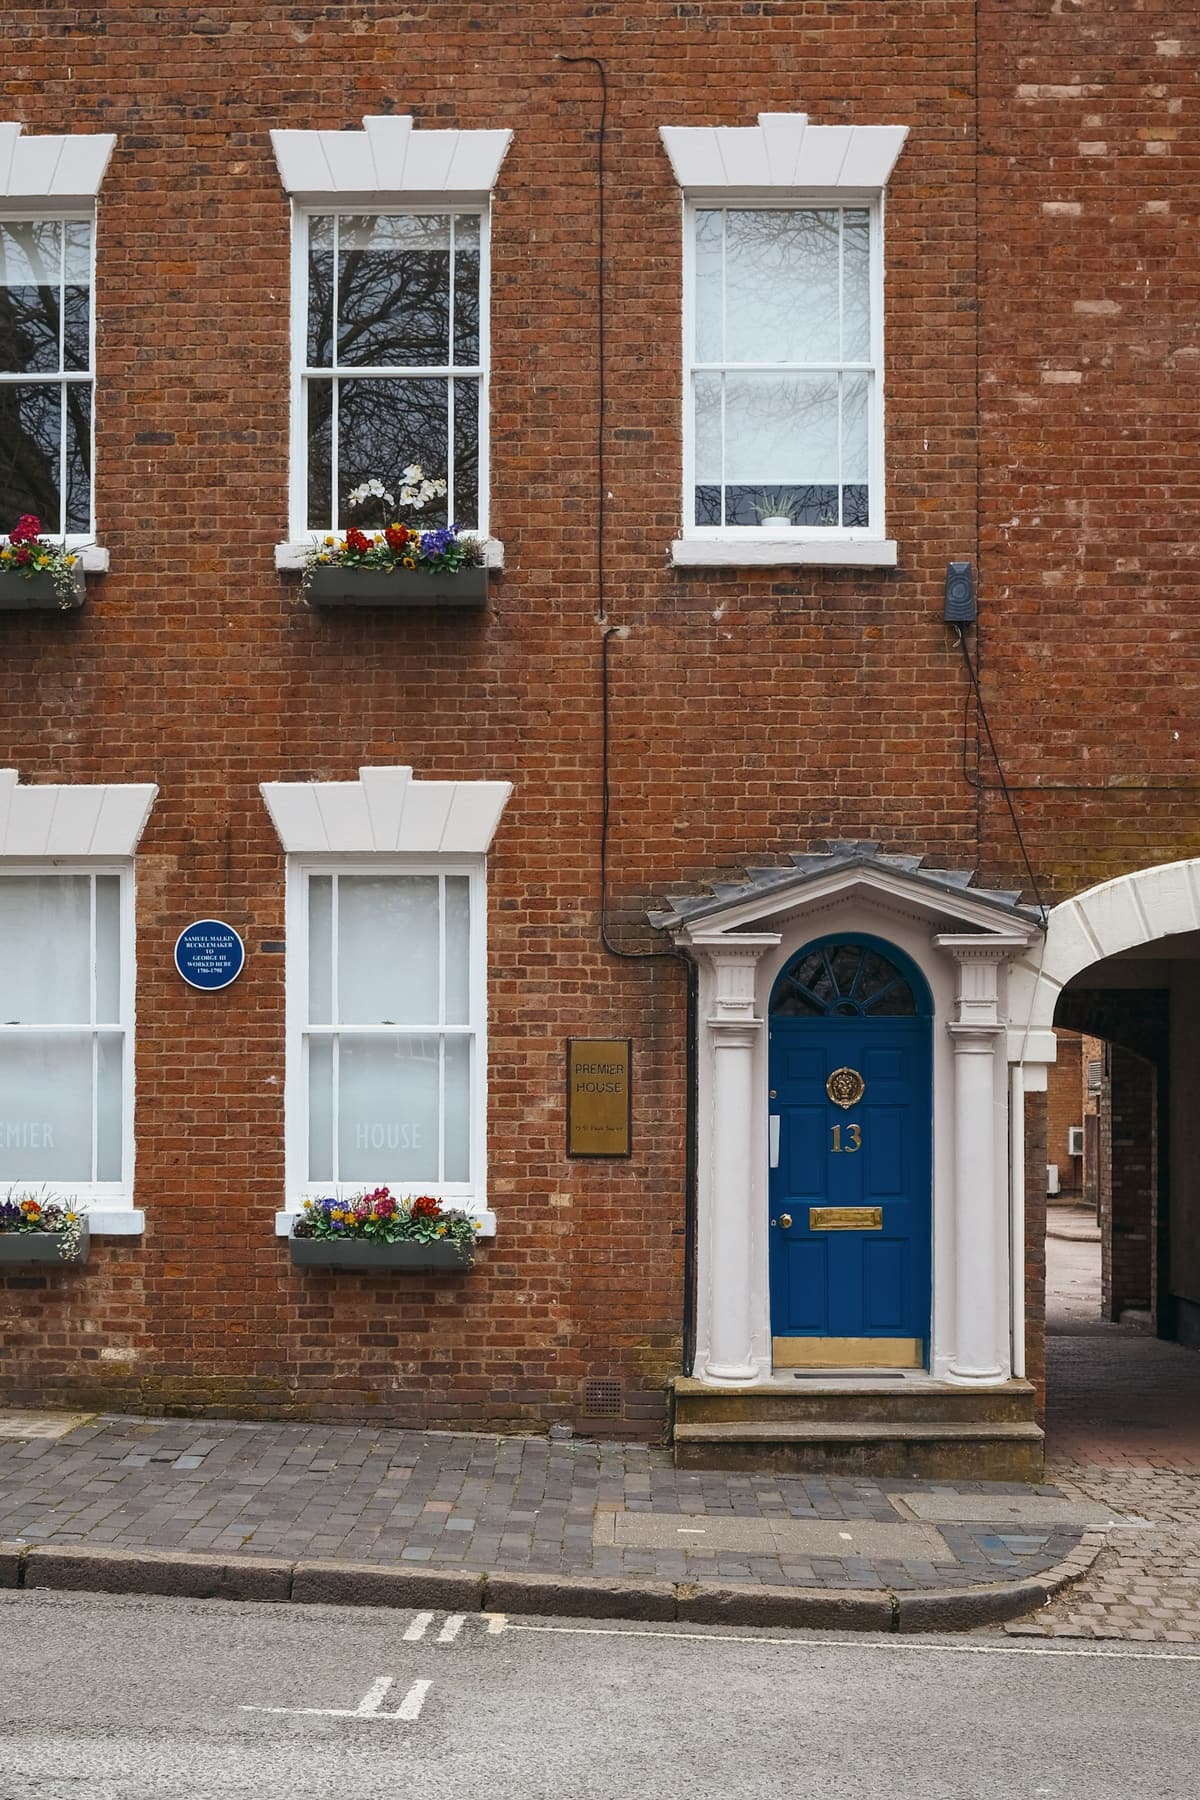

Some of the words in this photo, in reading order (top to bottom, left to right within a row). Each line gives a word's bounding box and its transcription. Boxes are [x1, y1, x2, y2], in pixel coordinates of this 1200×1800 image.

[576, 1063, 624, 1074] PREMIER
[577, 1082, 622, 1093] HOUSE
[356, 1123, 422, 1149] HOUSE
[830, 1123, 863, 1153] 13
